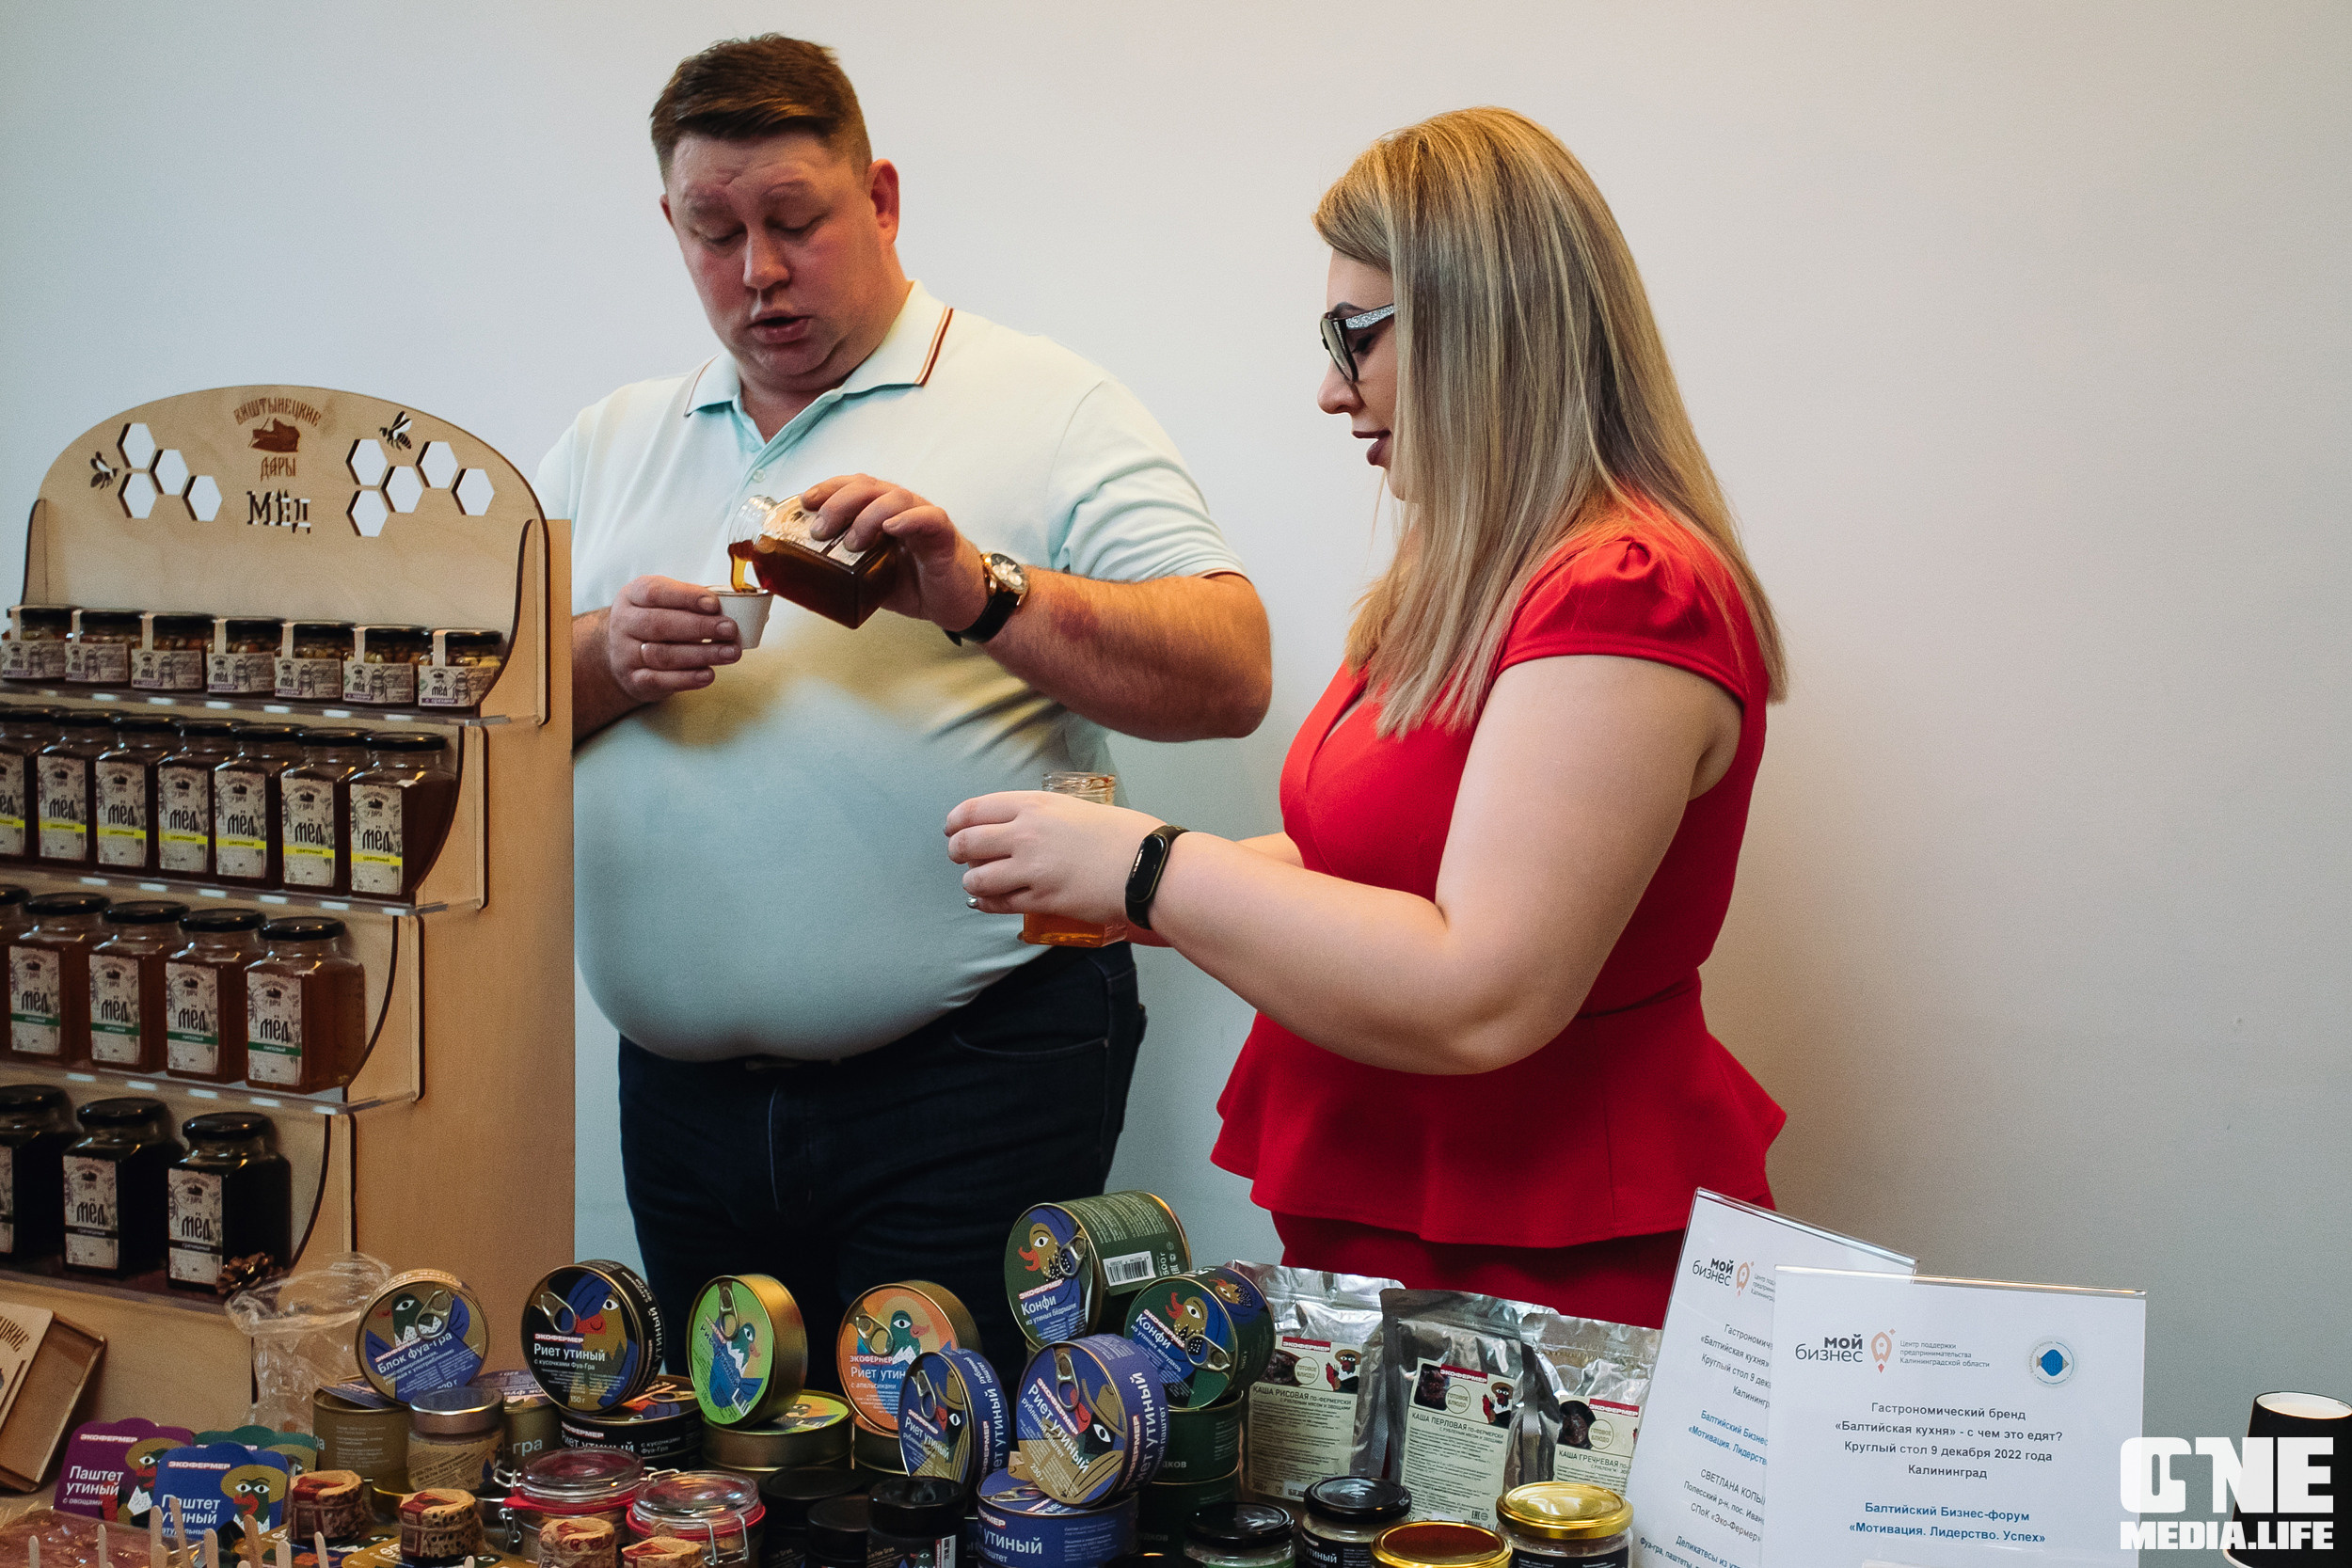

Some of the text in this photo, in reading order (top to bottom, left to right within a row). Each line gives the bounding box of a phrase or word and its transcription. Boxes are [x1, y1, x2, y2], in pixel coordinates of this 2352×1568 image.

[261, 456, 295, 482] ДАРЫ
[0, 792, 13, 815] ёд
[1692, 1259, 1732, 1287] бизнес
[1710, 1258, 1734, 1275] мой
[1021, 1294, 1057, 1316] Конфи
[534, 1334, 584, 1344] ЭКОФЕРМЕР
[1135, 1313, 1171, 1350] Конфи
[1724, 1323, 1773, 1351] Гастрономич
[1824, 1333, 1864, 1351] мой
[533, 1342, 606, 1362] Риет утиный
[1282, 1341, 1331, 1352] ЭКОФЕРМЕР
[1701, 1335, 1744, 1358] «Балтийская
[1795, 1343, 1864, 1364] бизнес
[1900, 1349, 1972, 1358] предпринимательства
[377, 1354, 406, 1374] Блок
[1701, 1353, 1772, 1389] Круглый стол 9 дека
[1900, 1357, 1961, 1367] Калининградской
[850, 1367, 906, 1382] Риет утин
[1439, 1369, 1488, 1384] ЭКОФЕРМЕР
[1253, 1386, 1274, 1396] КАША
[1275, 1389, 1310, 1401] РИСОВАЯ
[1733, 1386, 1771, 1410] Калинингр
[1037, 1377, 1079, 1435] ЭКОФЕРМЕР
[1129, 1371, 1158, 1449] утиный
[1589, 1403, 1639, 1418] ЭКОФЕРМЕР
[1871, 1402, 2026, 1421] Гастрономический бренд
[905, 1417, 924, 1437] Риет
[984, 1386, 1007, 1450] утиный
[1411, 1412, 1430, 1423] КАША
[1431, 1417, 1468, 1430] ПЕРЛОВАЯ
[1701, 1410, 1769, 1447] Балтийский Бизнес
[80, 1433, 138, 1443] ЭКОФЕРМЕР
[1027, 1384, 1054, 1421] Риет
[1050, 1419, 1090, 1474] утиный
[1835, 1420, 2063, 1443] «Балтийская кухня» с чем это едят?
[1045, 1432, 1065, 1459] паштет
[1688, 1425, 1768, 1465] «Мотивация. Лидерств
[1844, 1440, 2053, 1464] Круглый стол 9 декабря 2022 года
[168, 1461, 230, 1470] ЭКОФЕРМЕР
[1558, 1449, 1578, 1461] КАША
[1579, 1453, 1619, 1467] ГРЕЧНЕВАЯ
[69, 1465, 123, 1482] Паштет
[1700, 1468, 1740, 1494] СВЕТЛАНА
[1908, 1464, 1988, 1480] Калининград
[66, 1481, 120, 1497] утиный
[1691, 1502, 1710, 1520] СПоК
[1718, 1497, 1731, 1510] р-н,
[1731, 1504, 1744, 1516] пос.
[1746, 1509, 1765, 1526] Иван
[1865, 1502, 2030, 1523] Балтийский Бизнес-форум
[983, 1528, 1042, 1555] утиный
[1849, 1522, 2046, 1544] «Мотивация. Лидерство. Успех»
[1676, 1535, 1728, 1568] Деликатесы из
